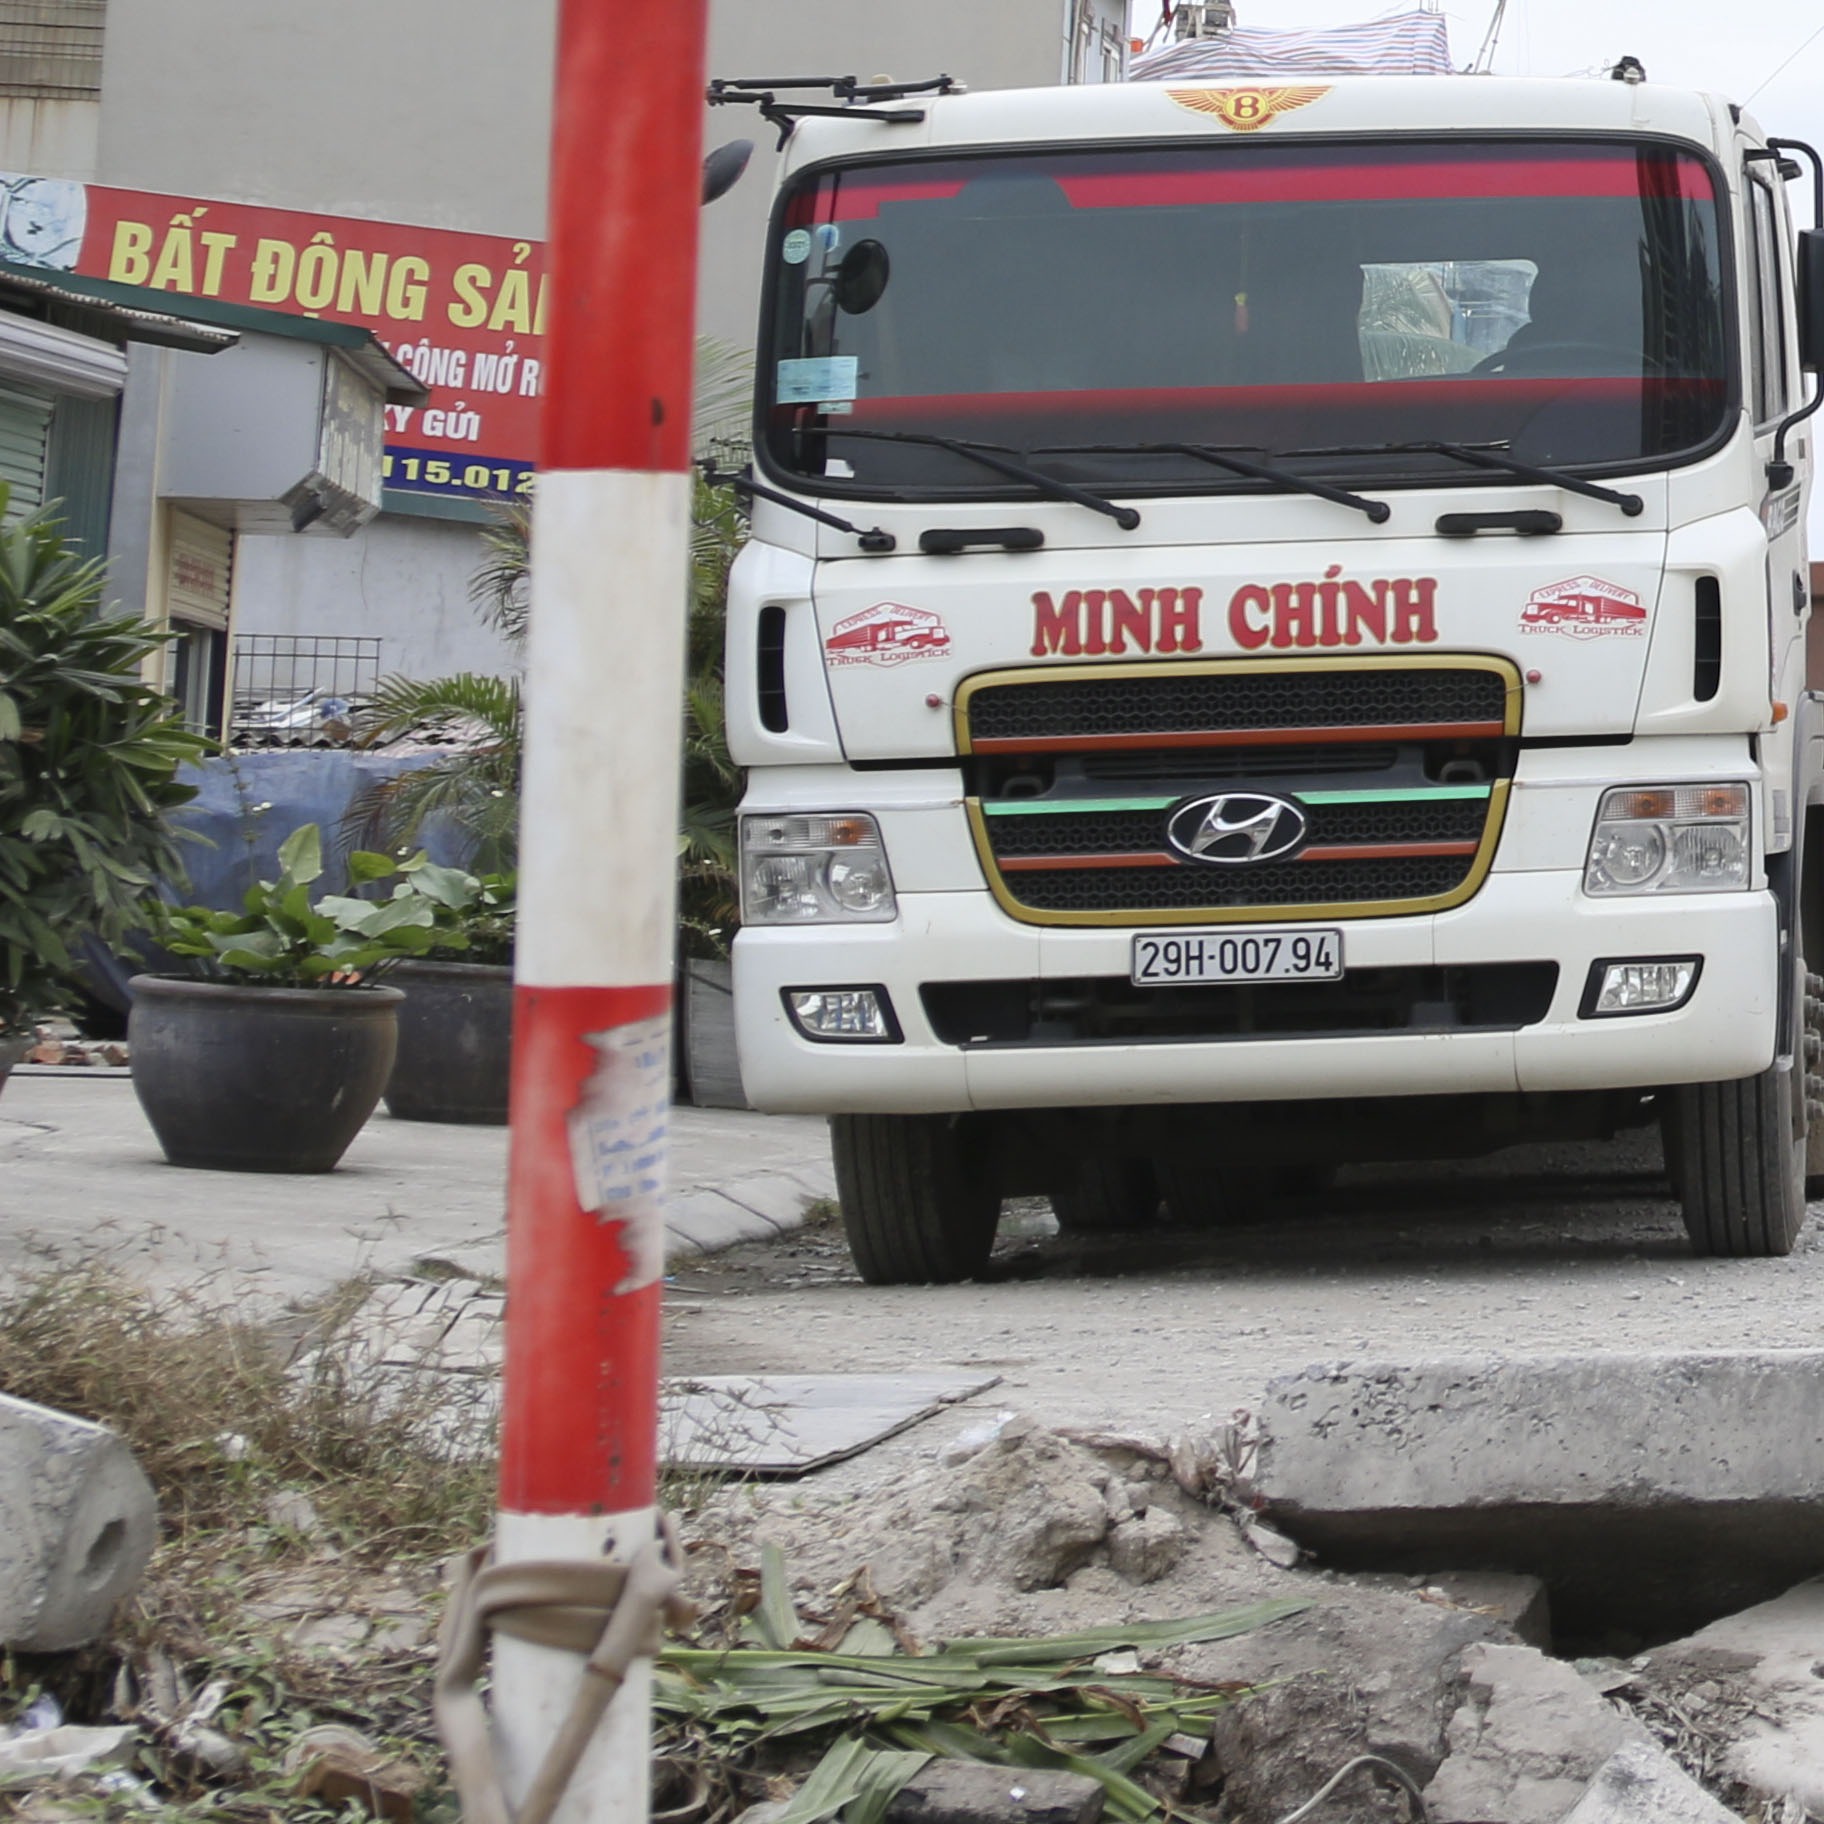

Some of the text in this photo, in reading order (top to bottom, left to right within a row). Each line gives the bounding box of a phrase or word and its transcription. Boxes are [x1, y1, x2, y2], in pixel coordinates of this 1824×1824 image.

[108, 207, 237, 297] BẤT
[250, 232, 430, 321] ĐỘNG
[470, 340, 518, 395] MỞ
[422, 401, 481, 441] GỬI
[1031, 564, 1438, 657] MINH CHÍNH
[1519, 624, 1564, 633] TRUCK
[826, 655, 873, 666] TRUCK
[1140, 936, 1333, 977] 29H-007.94
